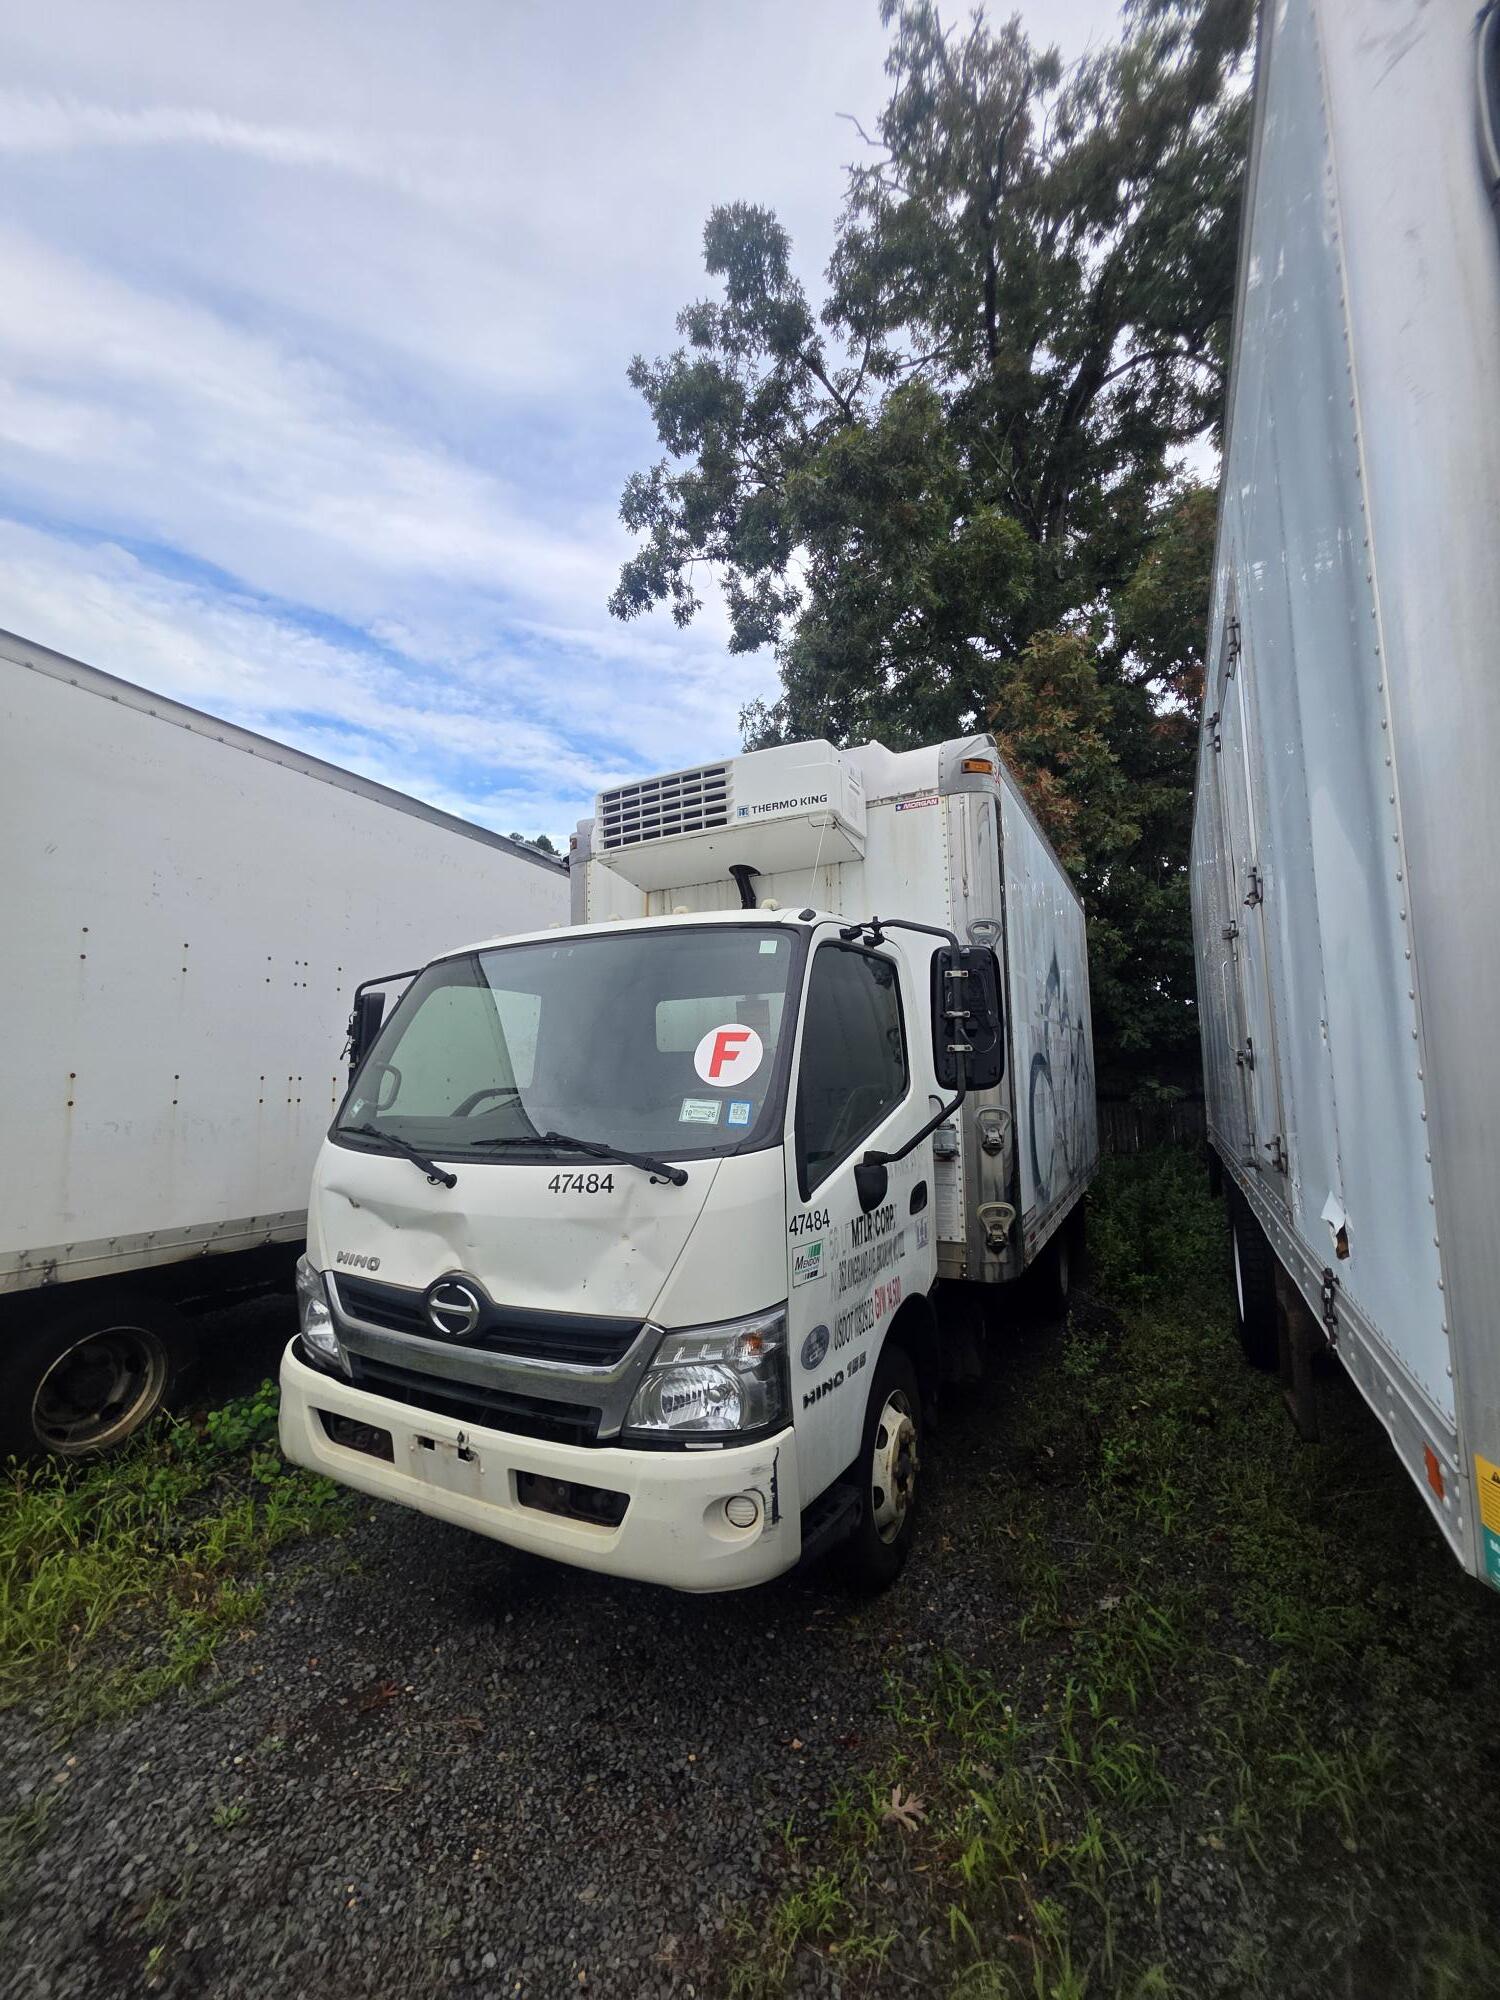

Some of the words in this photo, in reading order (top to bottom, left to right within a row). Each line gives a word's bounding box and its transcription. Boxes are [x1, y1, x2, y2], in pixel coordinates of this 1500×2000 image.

[751, 799, 798, 814] THERMO
[800, 794, 828, 806] KING
[902, 798, 938, 810] MORGAN
[708, 1032, 751, 1078] F
[548, 1174, 614, 1194] 47484
[789, 1208, 830, 1236] 47484
[336, 1250, 381, 1271] HINO
[802, 1370, 845, 1410] HINO
